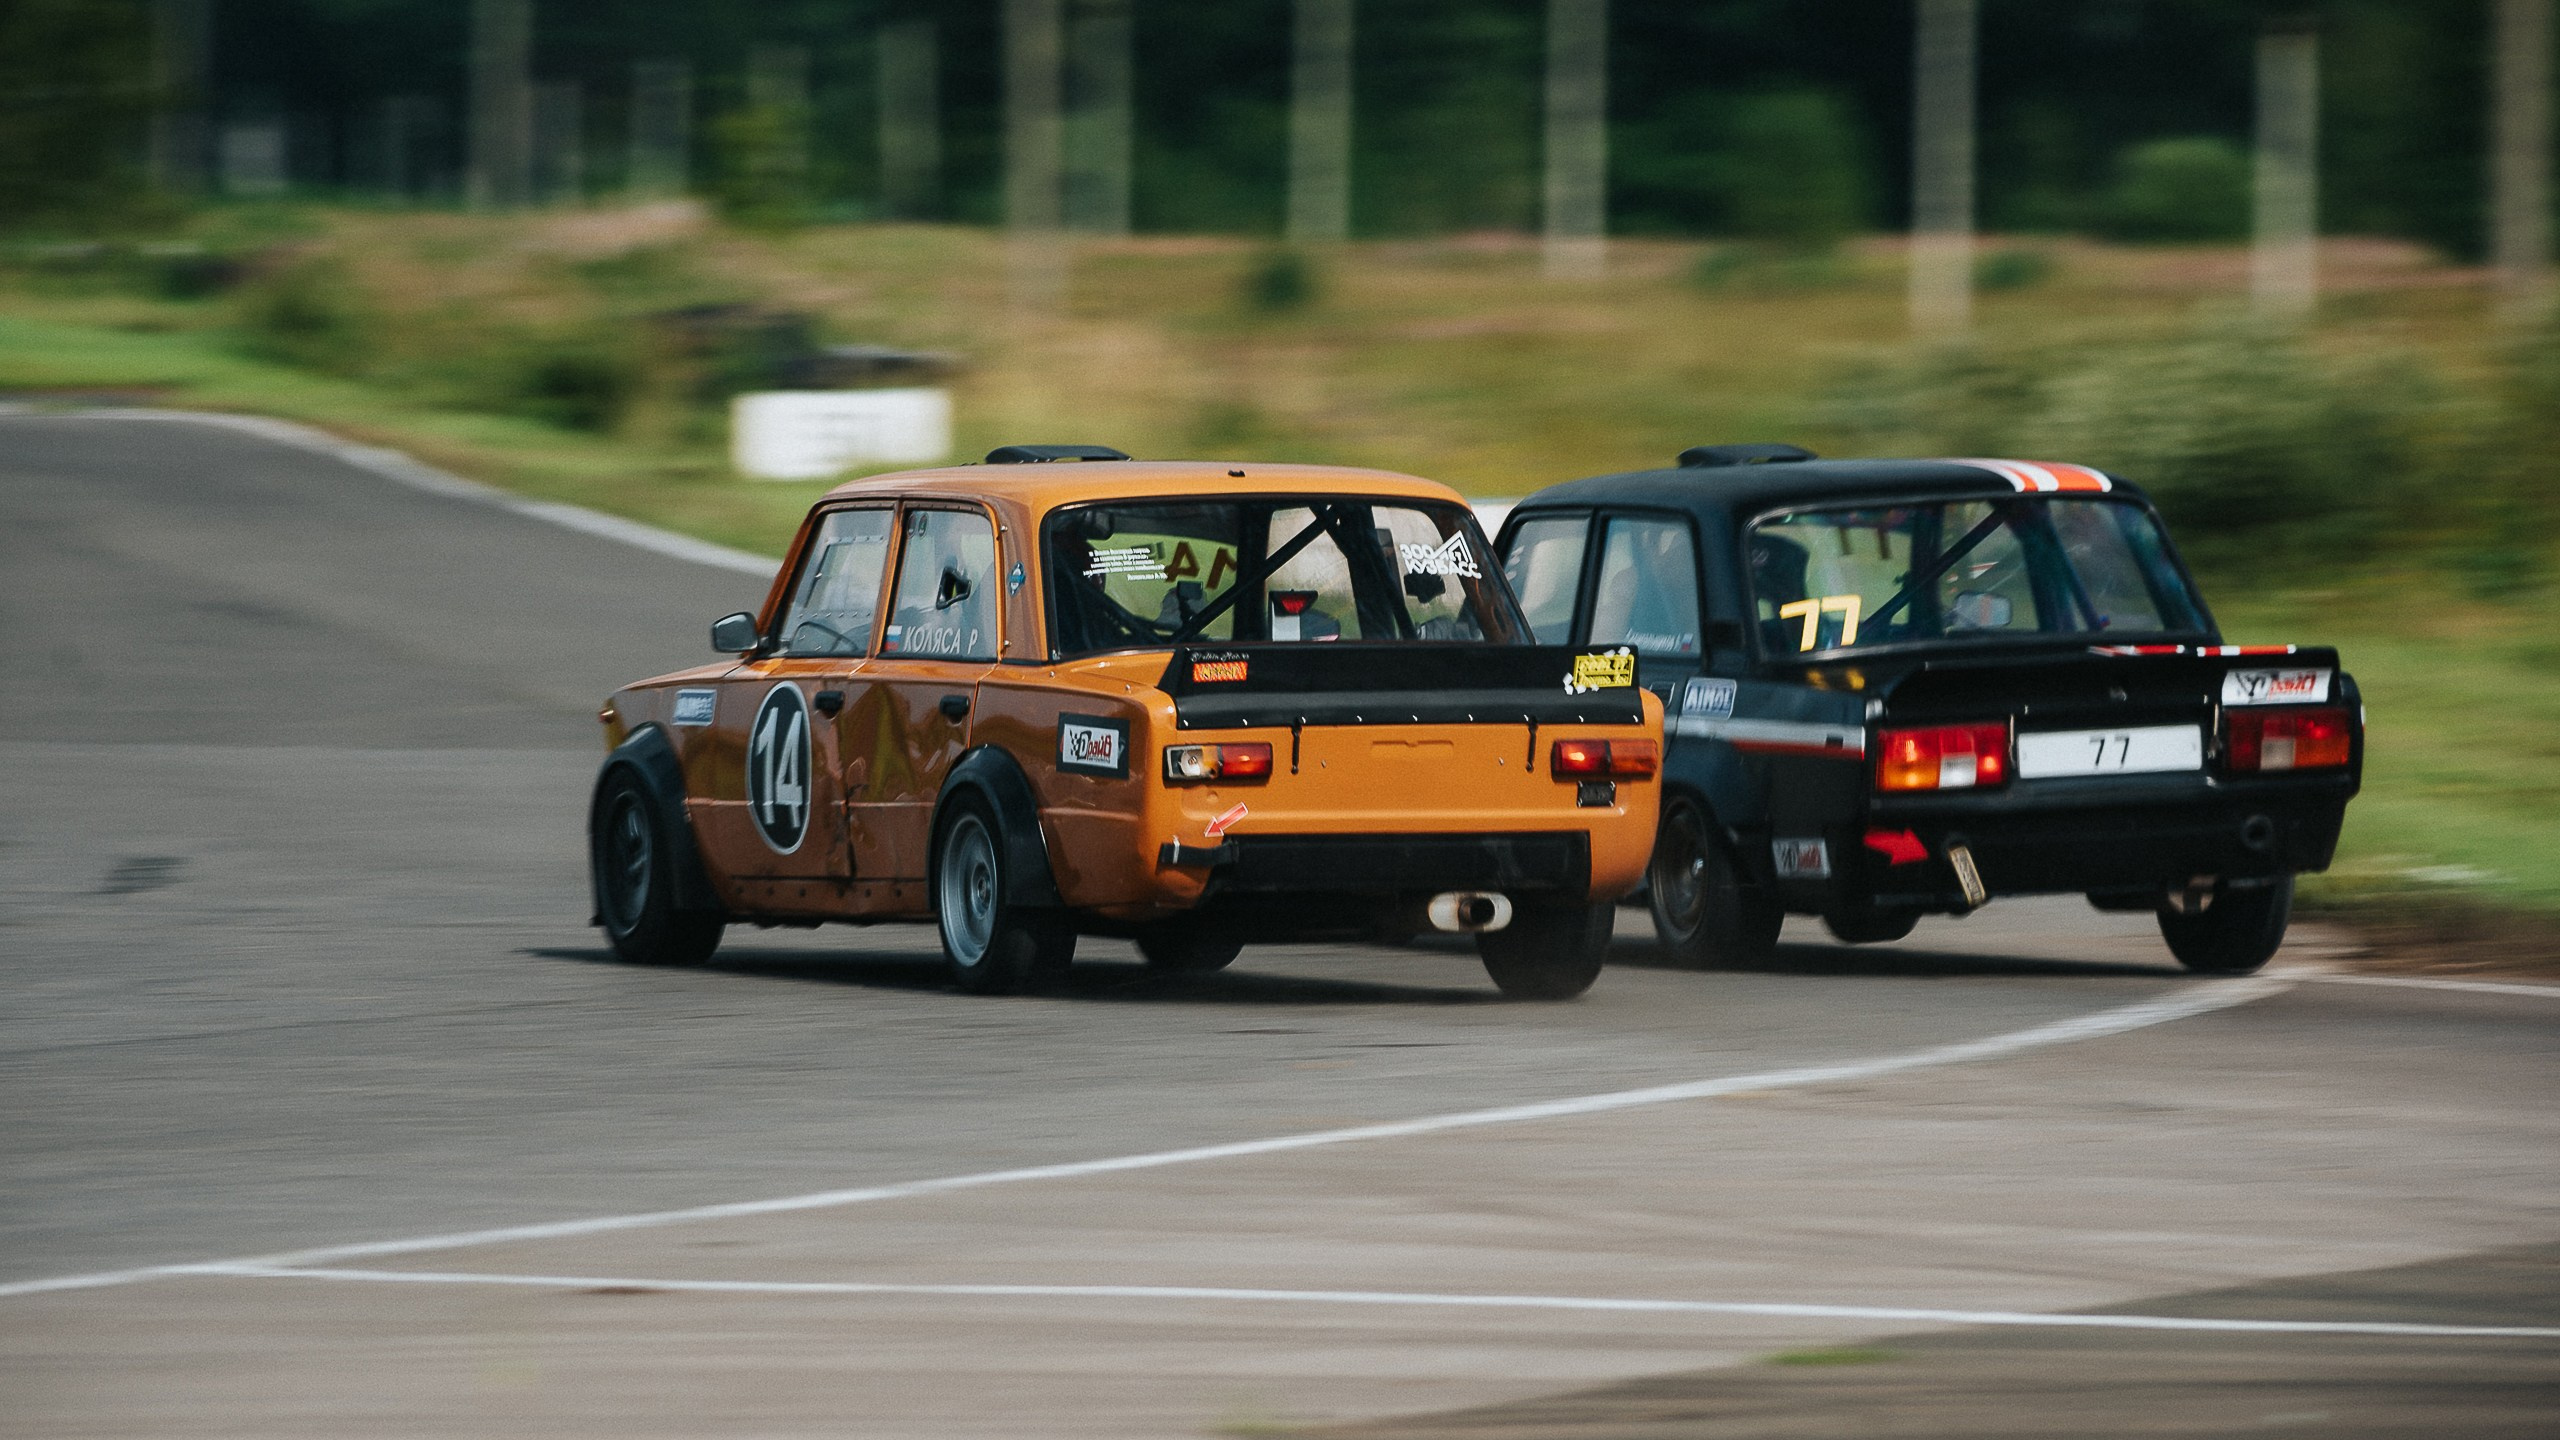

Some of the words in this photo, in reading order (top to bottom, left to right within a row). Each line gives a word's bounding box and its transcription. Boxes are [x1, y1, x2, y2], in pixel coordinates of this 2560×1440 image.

[903, 625, 961, 655] КОЛЯСА
[967, 628, 979, 655] Р
[1779, 594, 1862, 652] 77
[756, 706, 803, 828] 14
